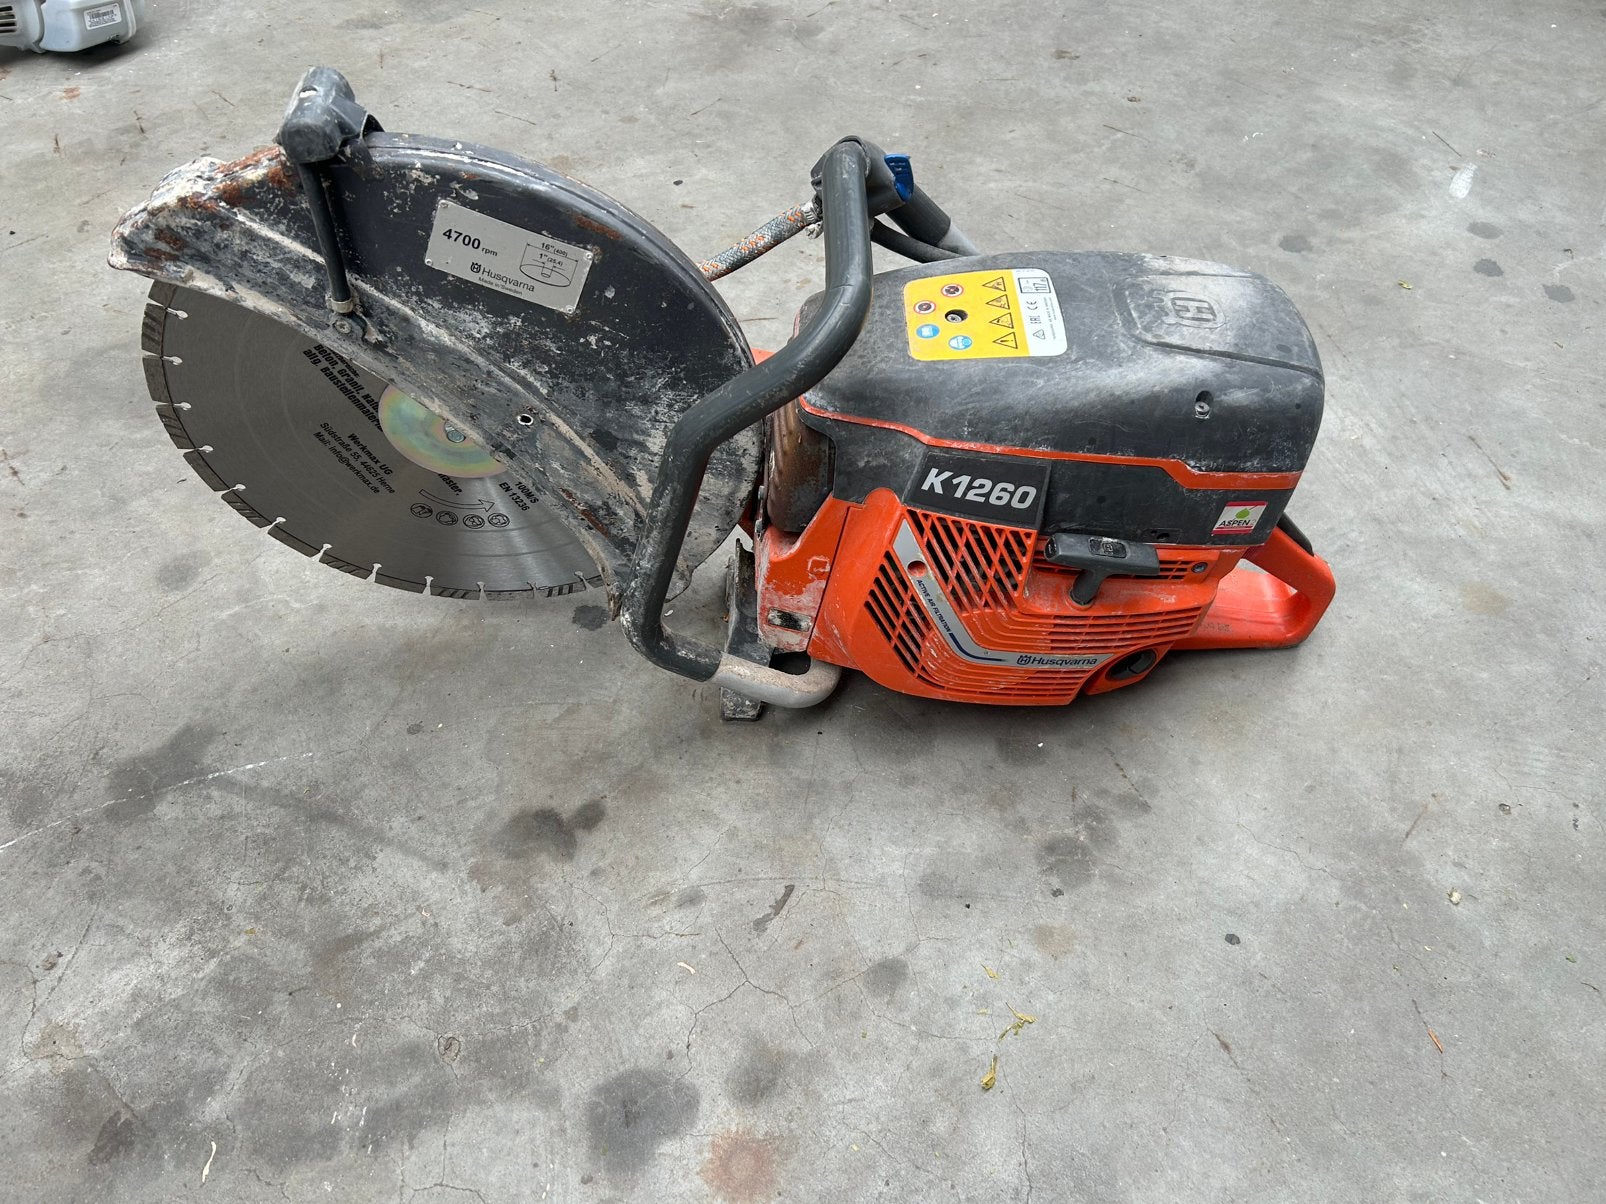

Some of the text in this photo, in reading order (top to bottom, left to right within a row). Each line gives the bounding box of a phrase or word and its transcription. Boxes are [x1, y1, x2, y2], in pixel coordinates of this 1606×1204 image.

[443, 229, 498, 257] 4700 rpm
[479, 277, 493, 286] Made
[501, 285, 523, 295] Sweden
[482, 267, 535, 292] Husqvarna
[313, 344, 338, 369] Beton,
[337, 369, 365, 394] Granit,
[313, 431, 380, 494] Mail: info@werkmax.de
[320, 422, 352, 453] Südstraße
[376, 476, 395, 494] Herne
[348, 433, 393, 475] Werkmax UG
[499, 481, 531, 512] EN 13236
[515, 481, 539, 504] 100M/S
[921, 467, 1037, 509] K1260
[917, 580, 951, 632] ACTIVE AIR FILTRATION
[1031, 656, 1097, 666] Husqvarna
